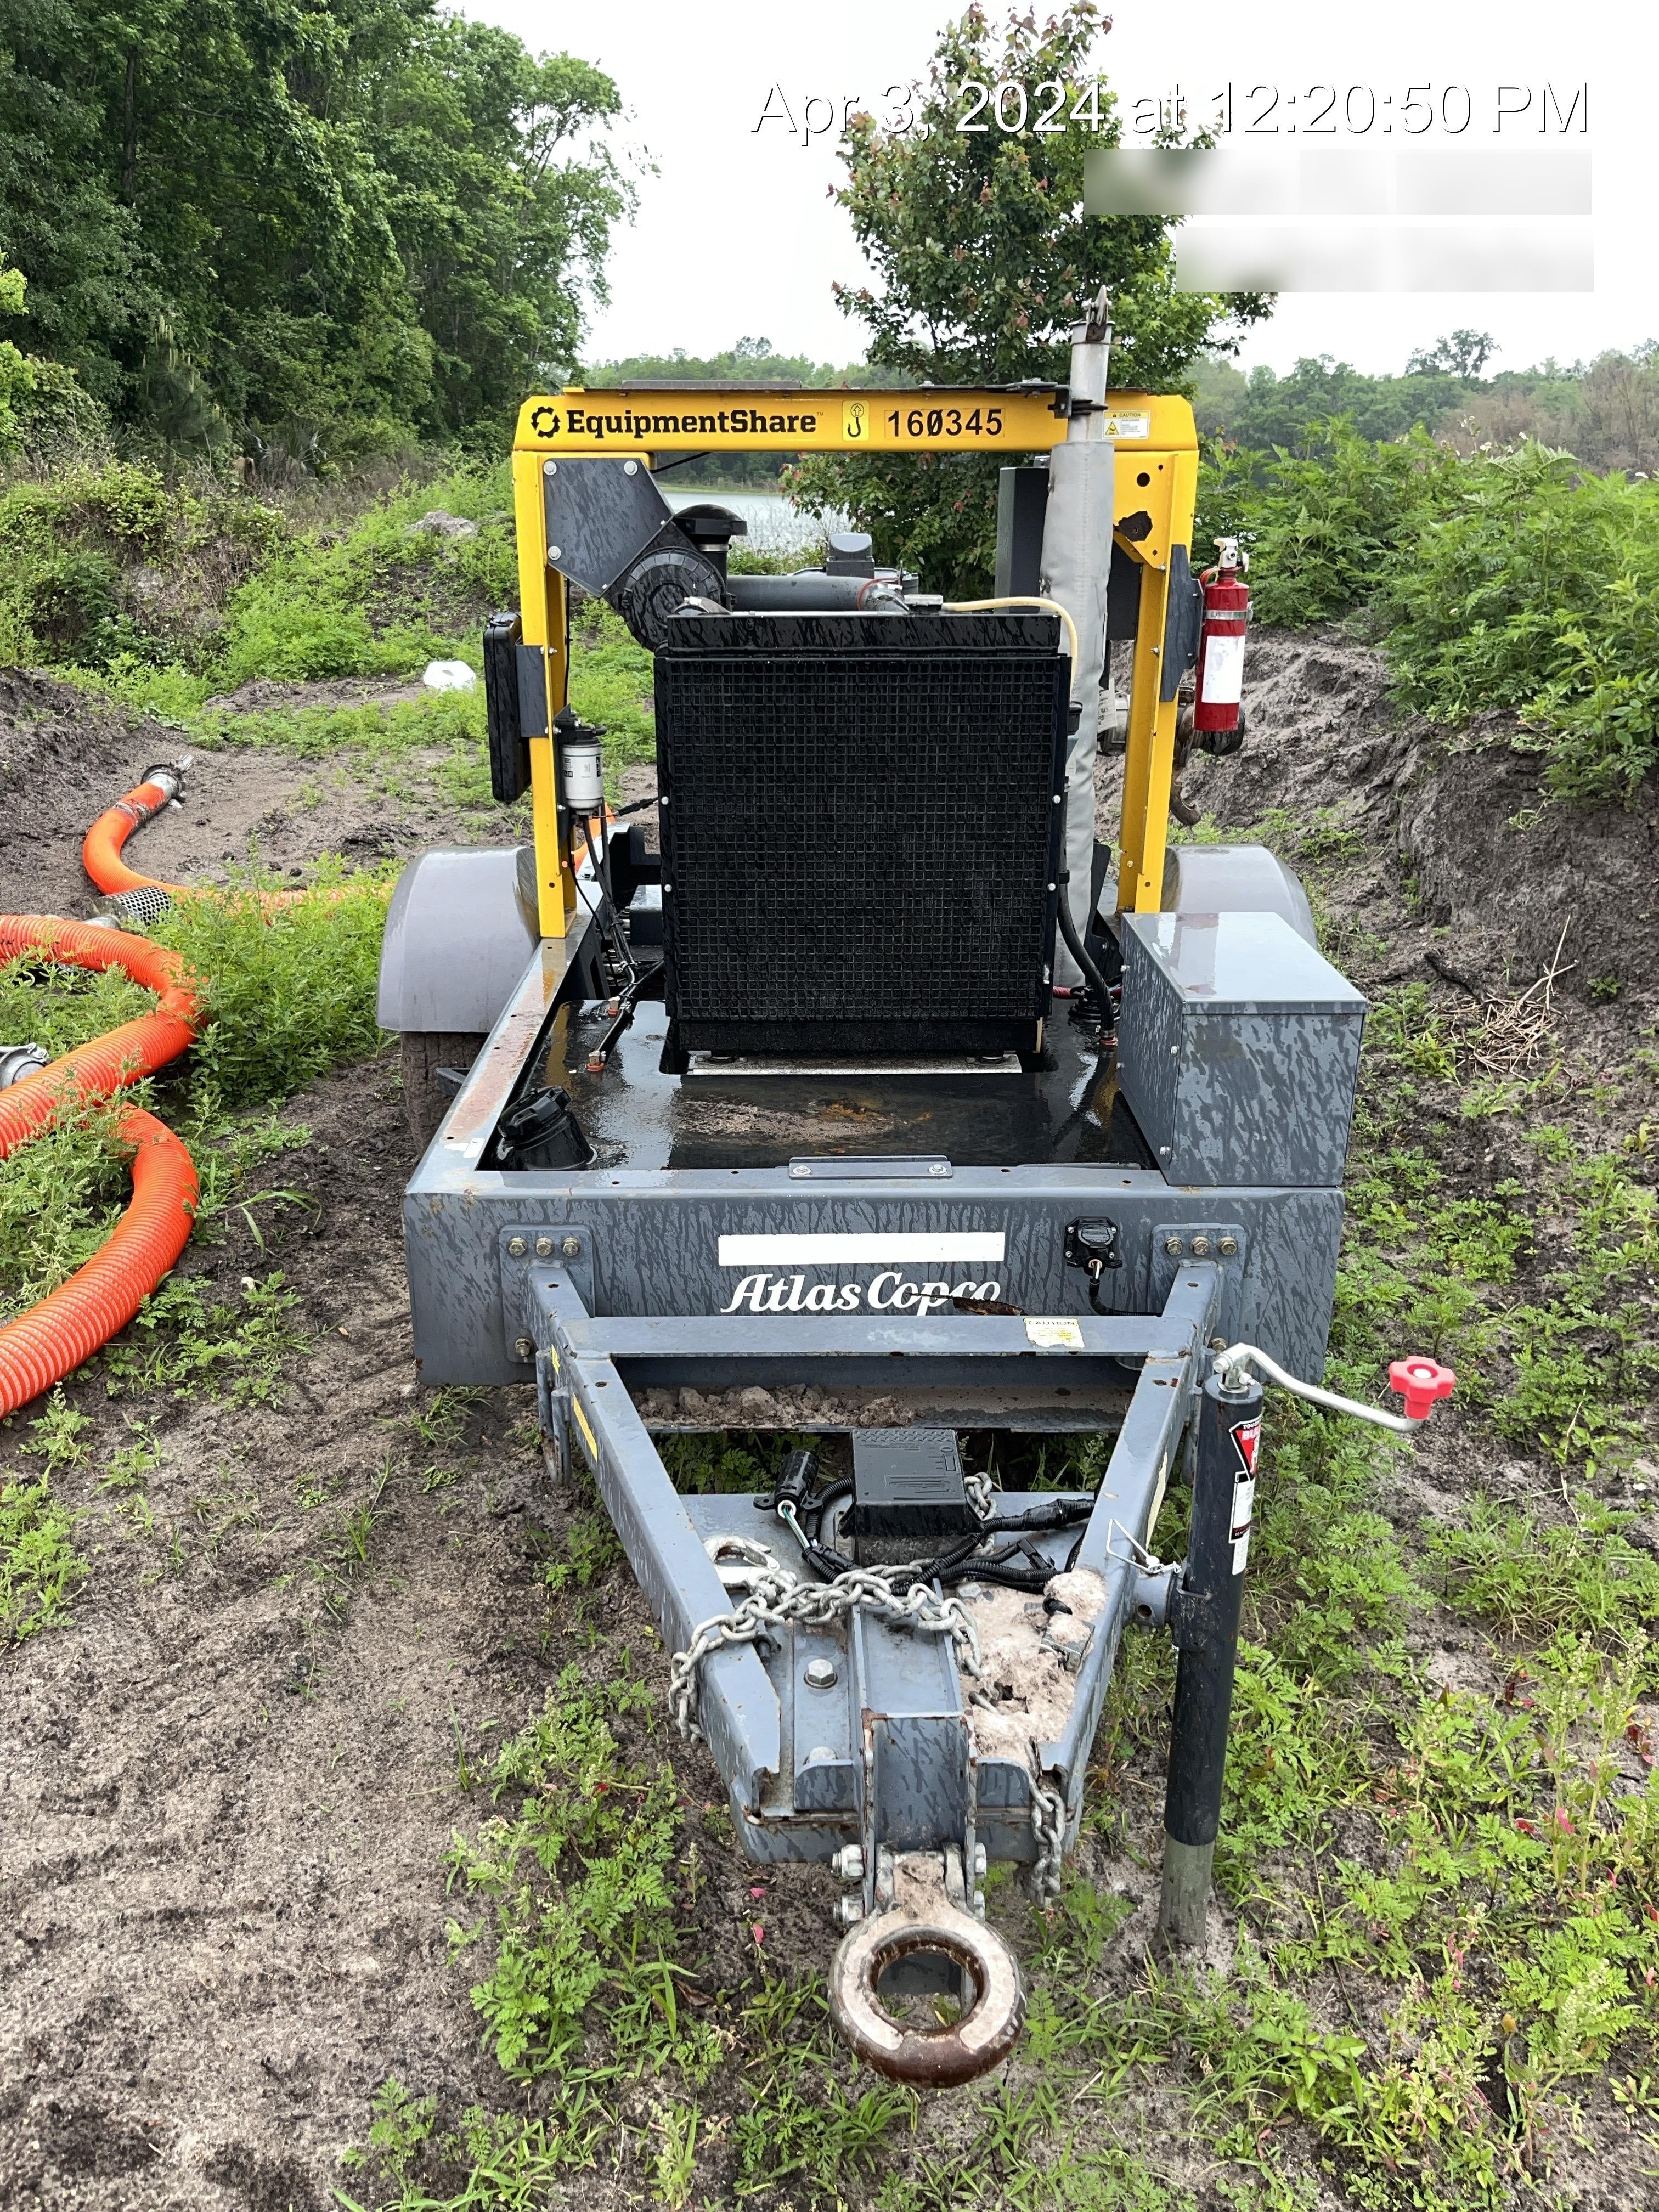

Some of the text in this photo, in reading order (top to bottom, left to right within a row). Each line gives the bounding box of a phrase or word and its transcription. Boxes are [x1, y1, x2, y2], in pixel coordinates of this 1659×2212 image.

[567, 410, 816, 438] EquipmentShare
[720, 1272, 1001, 1316] Atlas Copco
